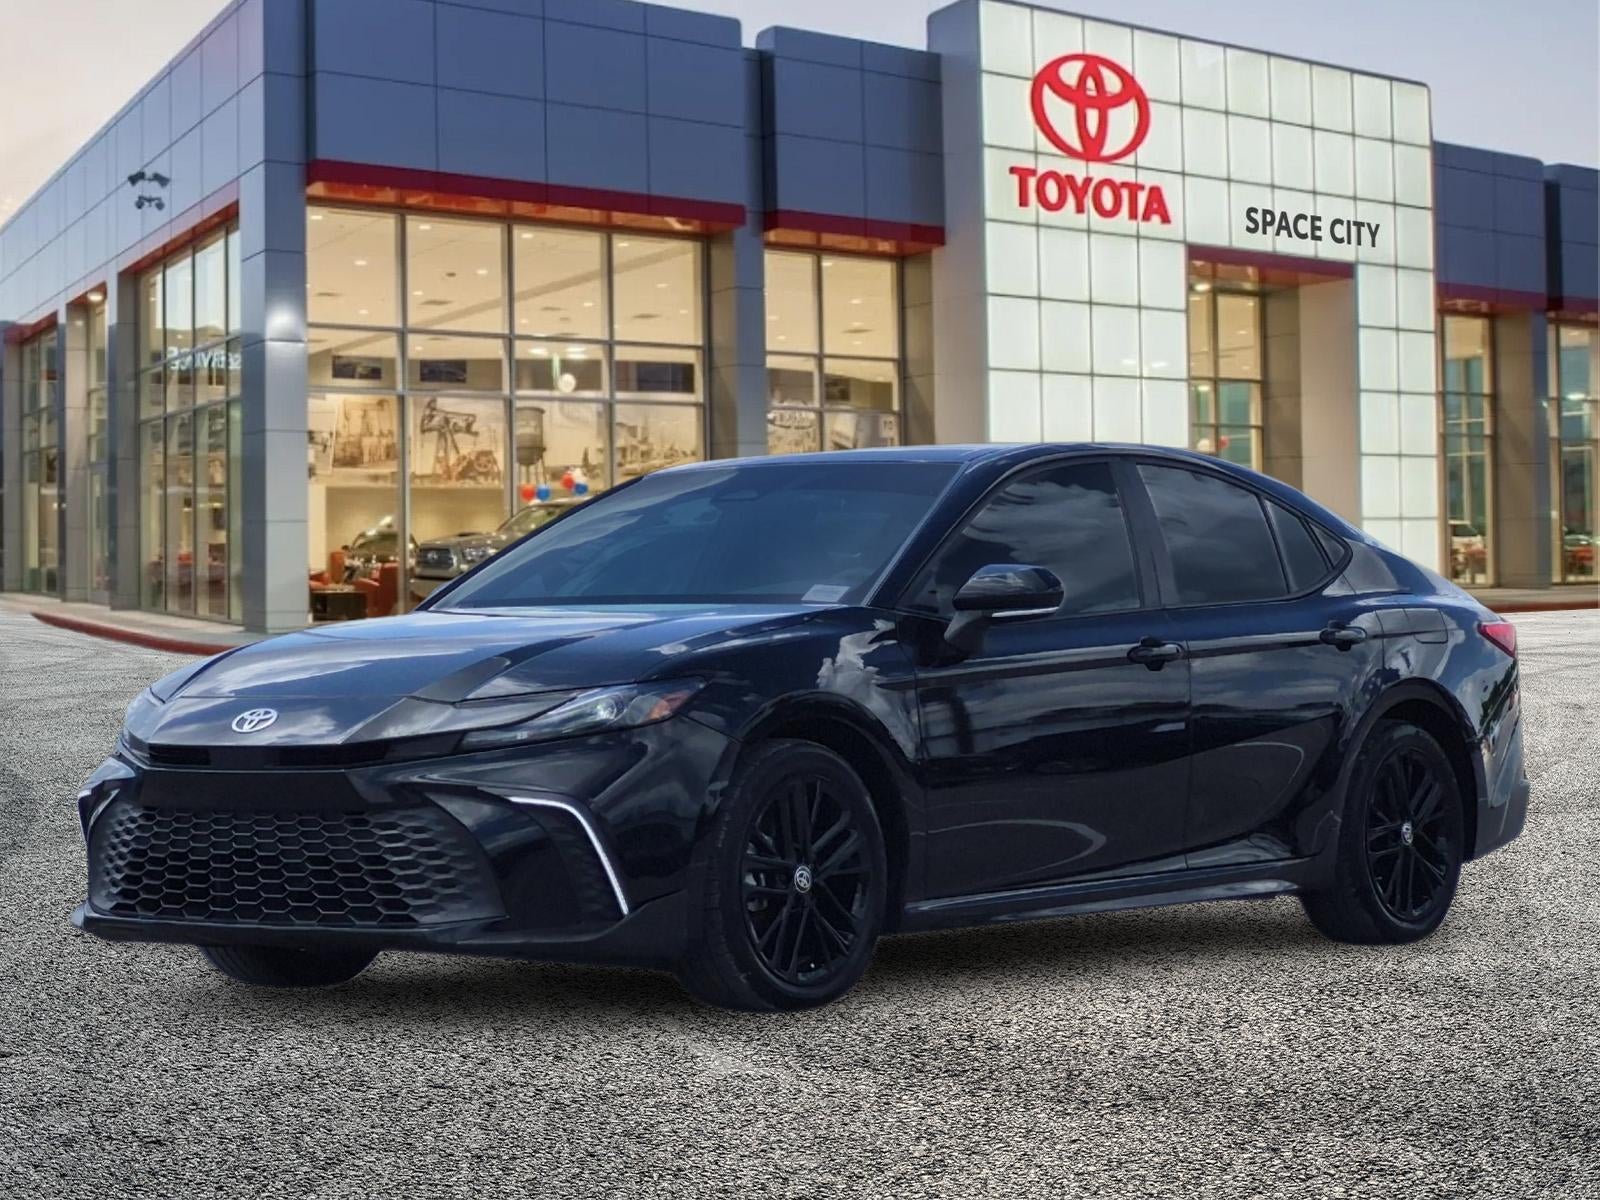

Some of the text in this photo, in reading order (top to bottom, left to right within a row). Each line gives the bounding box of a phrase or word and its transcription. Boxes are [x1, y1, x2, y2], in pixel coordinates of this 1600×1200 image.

[1009, 165, 1171, 224] TOYOTA
[1245, 206, 1381, 248] SPACE CITY
